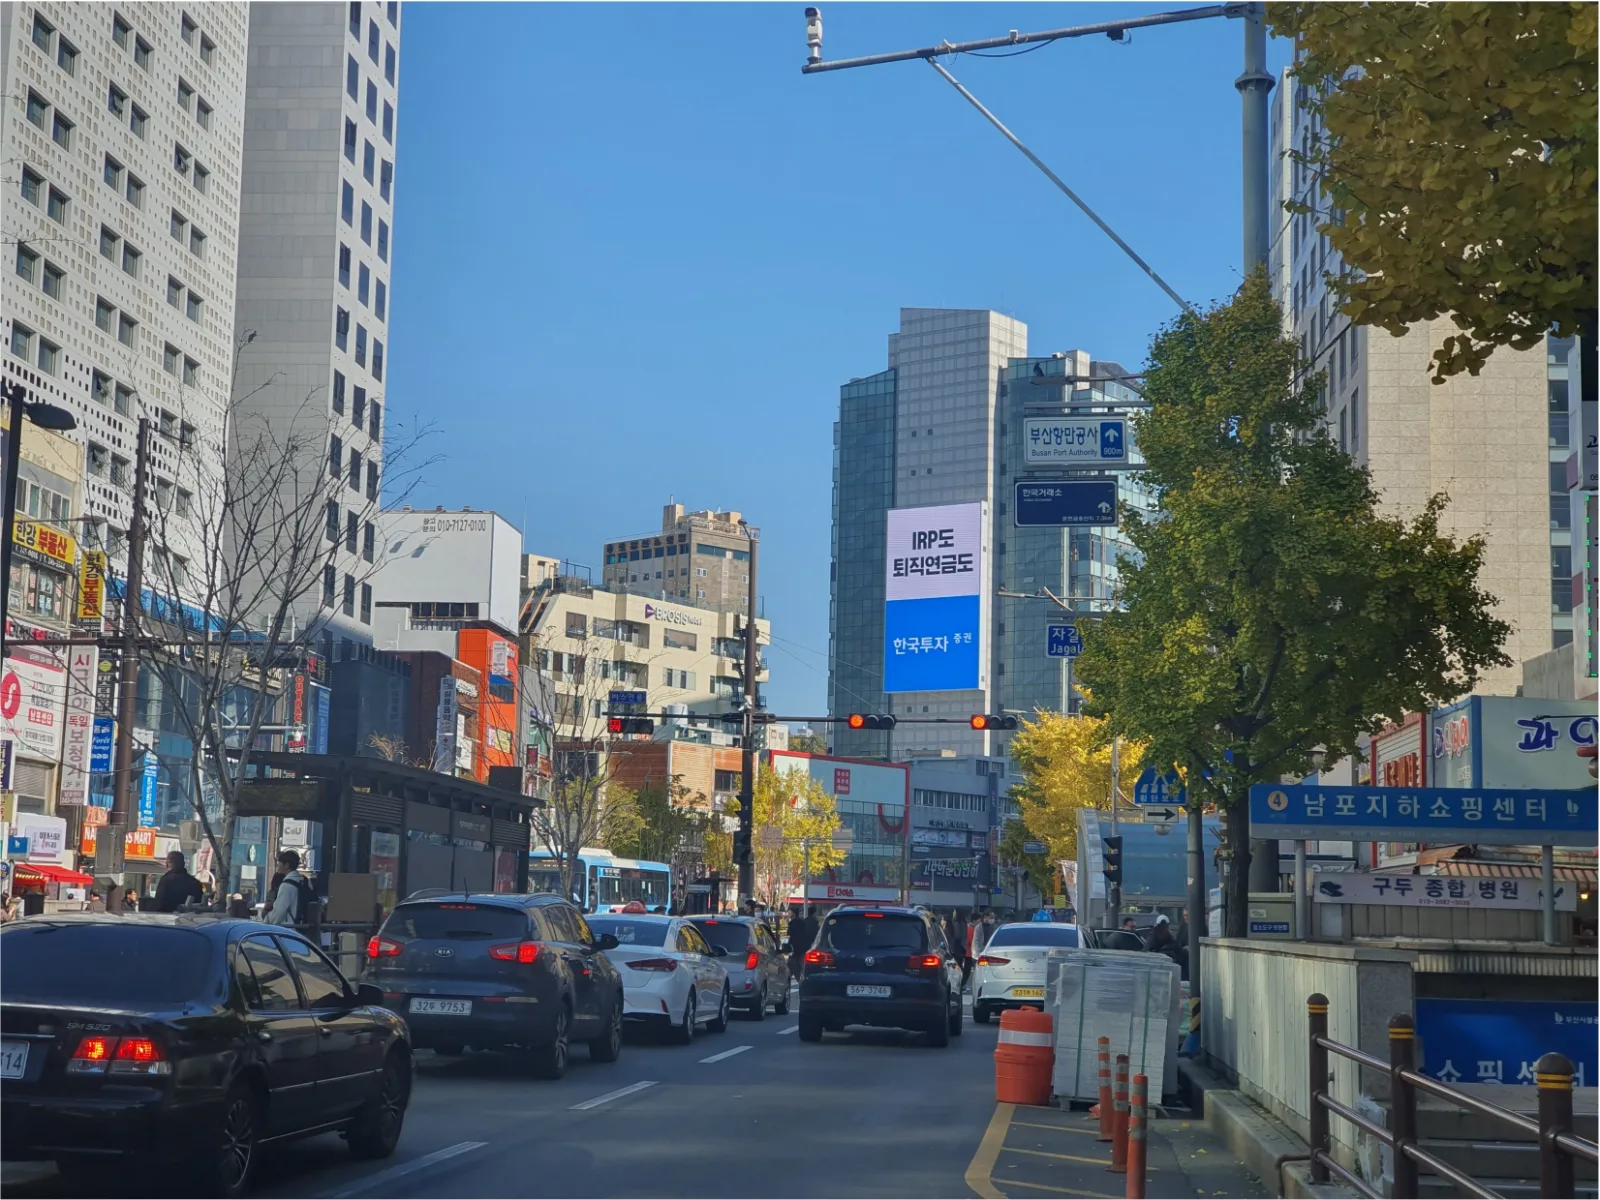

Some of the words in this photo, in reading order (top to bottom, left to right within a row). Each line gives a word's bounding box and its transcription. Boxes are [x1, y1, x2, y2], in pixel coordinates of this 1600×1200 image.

[1030, 427, 1098, 446] 부산항만공사
[1032, 449, 1051, 457] Busan
[1053, 448, 1067, 456] Port
[1068, 448, 1098, 457] Authority
[1103, 447, 1122, 455] 900m
[1022, 488, 1063, 497] 한국거래소
[437, 519, 487, 532] 010-7127-0100
[16, 521, 37, 547] 한강
[38, 528, 68, 559] 부동산
[912, 528, 955, 550] IRP도
[893, 553, 974, 577] 퇴직연금도
[655, 607, 688, 626] BROSIS
[893, 636, 949, 655] 한국투자
[953, 632, 972, 644] 증권
[1052, 628, 1079, 643] 자갈
[1051, 643, 1085, 656] Jagal
[1274, 793, 1282, 808] 4
[1304, 793, 1547, 822] 남포지하쇼핑센터
[1372, 877, 1414, 897] 구두
[1425, 879, 1466, 899] 종합
[1479, 880, 1519, 900] 병원
[440, 1002, 465, 1012] 9753
[67, 1022, 85, 1031] SM
[86, 1023, 111, 1031] 520
[1, 1053, 22, 1071] 14
